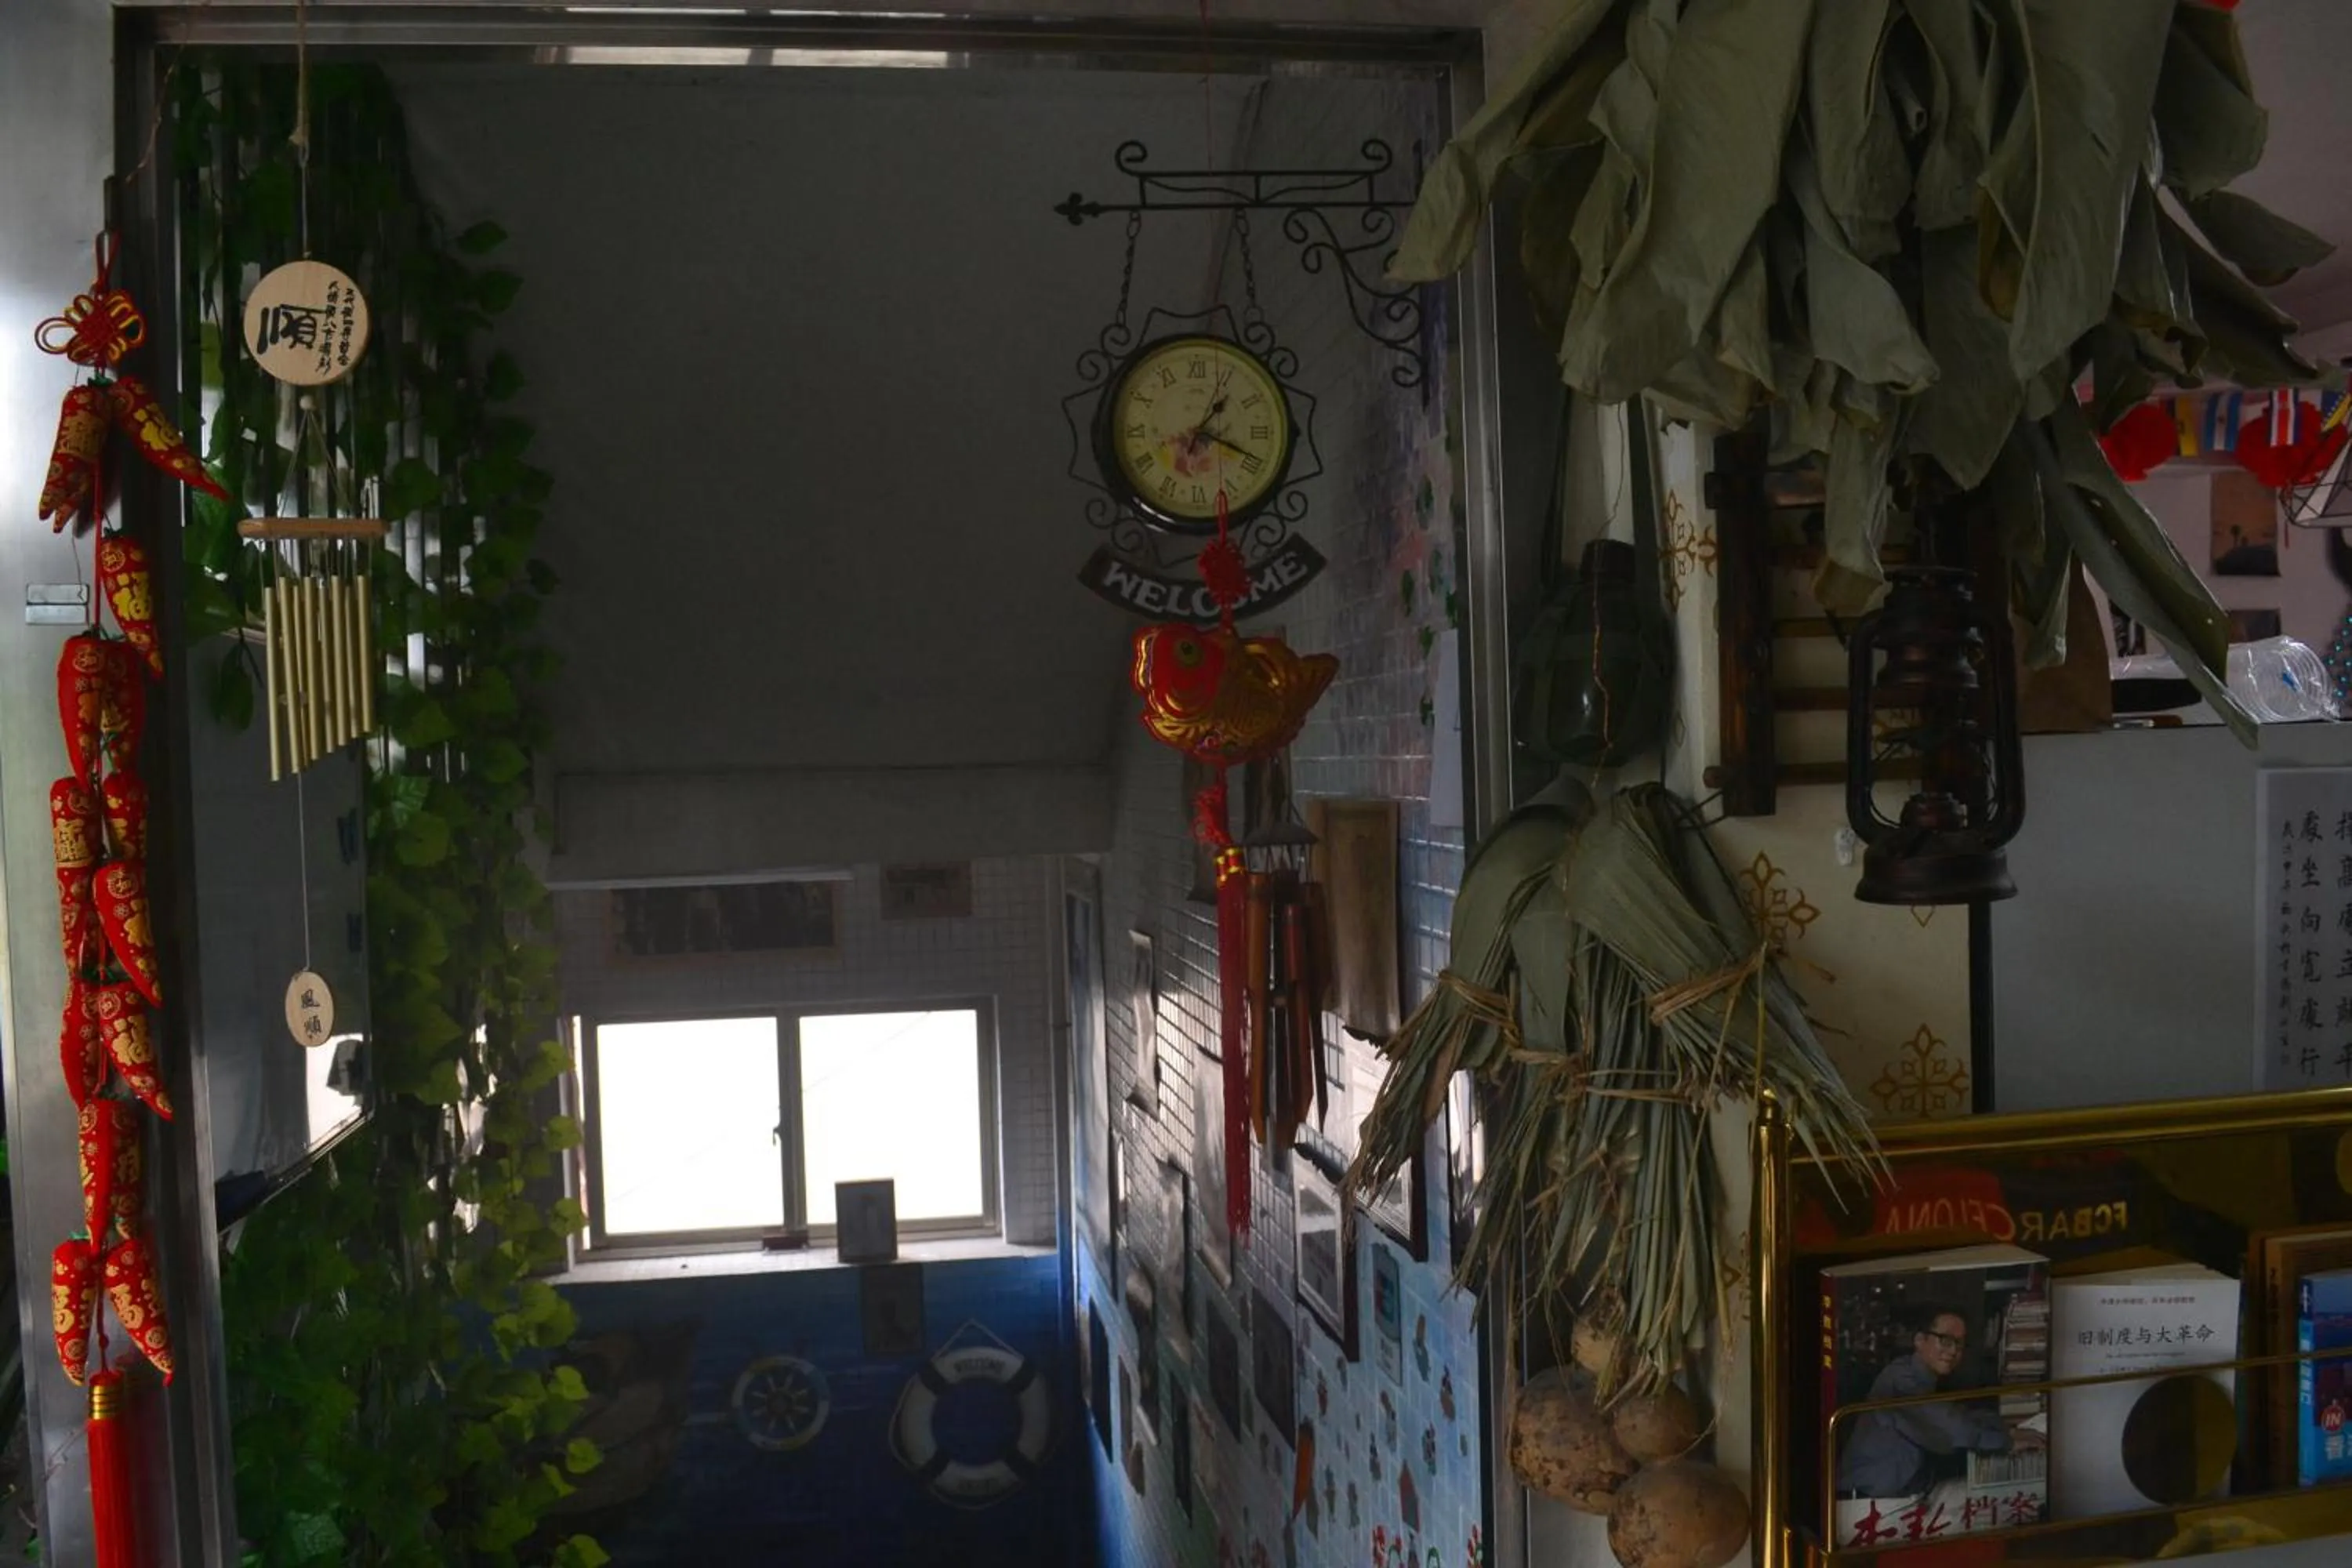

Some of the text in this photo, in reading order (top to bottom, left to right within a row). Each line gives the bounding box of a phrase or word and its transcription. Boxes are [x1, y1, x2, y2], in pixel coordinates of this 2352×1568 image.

[1250, 426, 1269, 440] III
[1102, 550, 1308, 618] WELCME
[2078, 1323, 2216, 1346] 旧制度与大革命
[2325, 1432, 2352, 1461] 香
